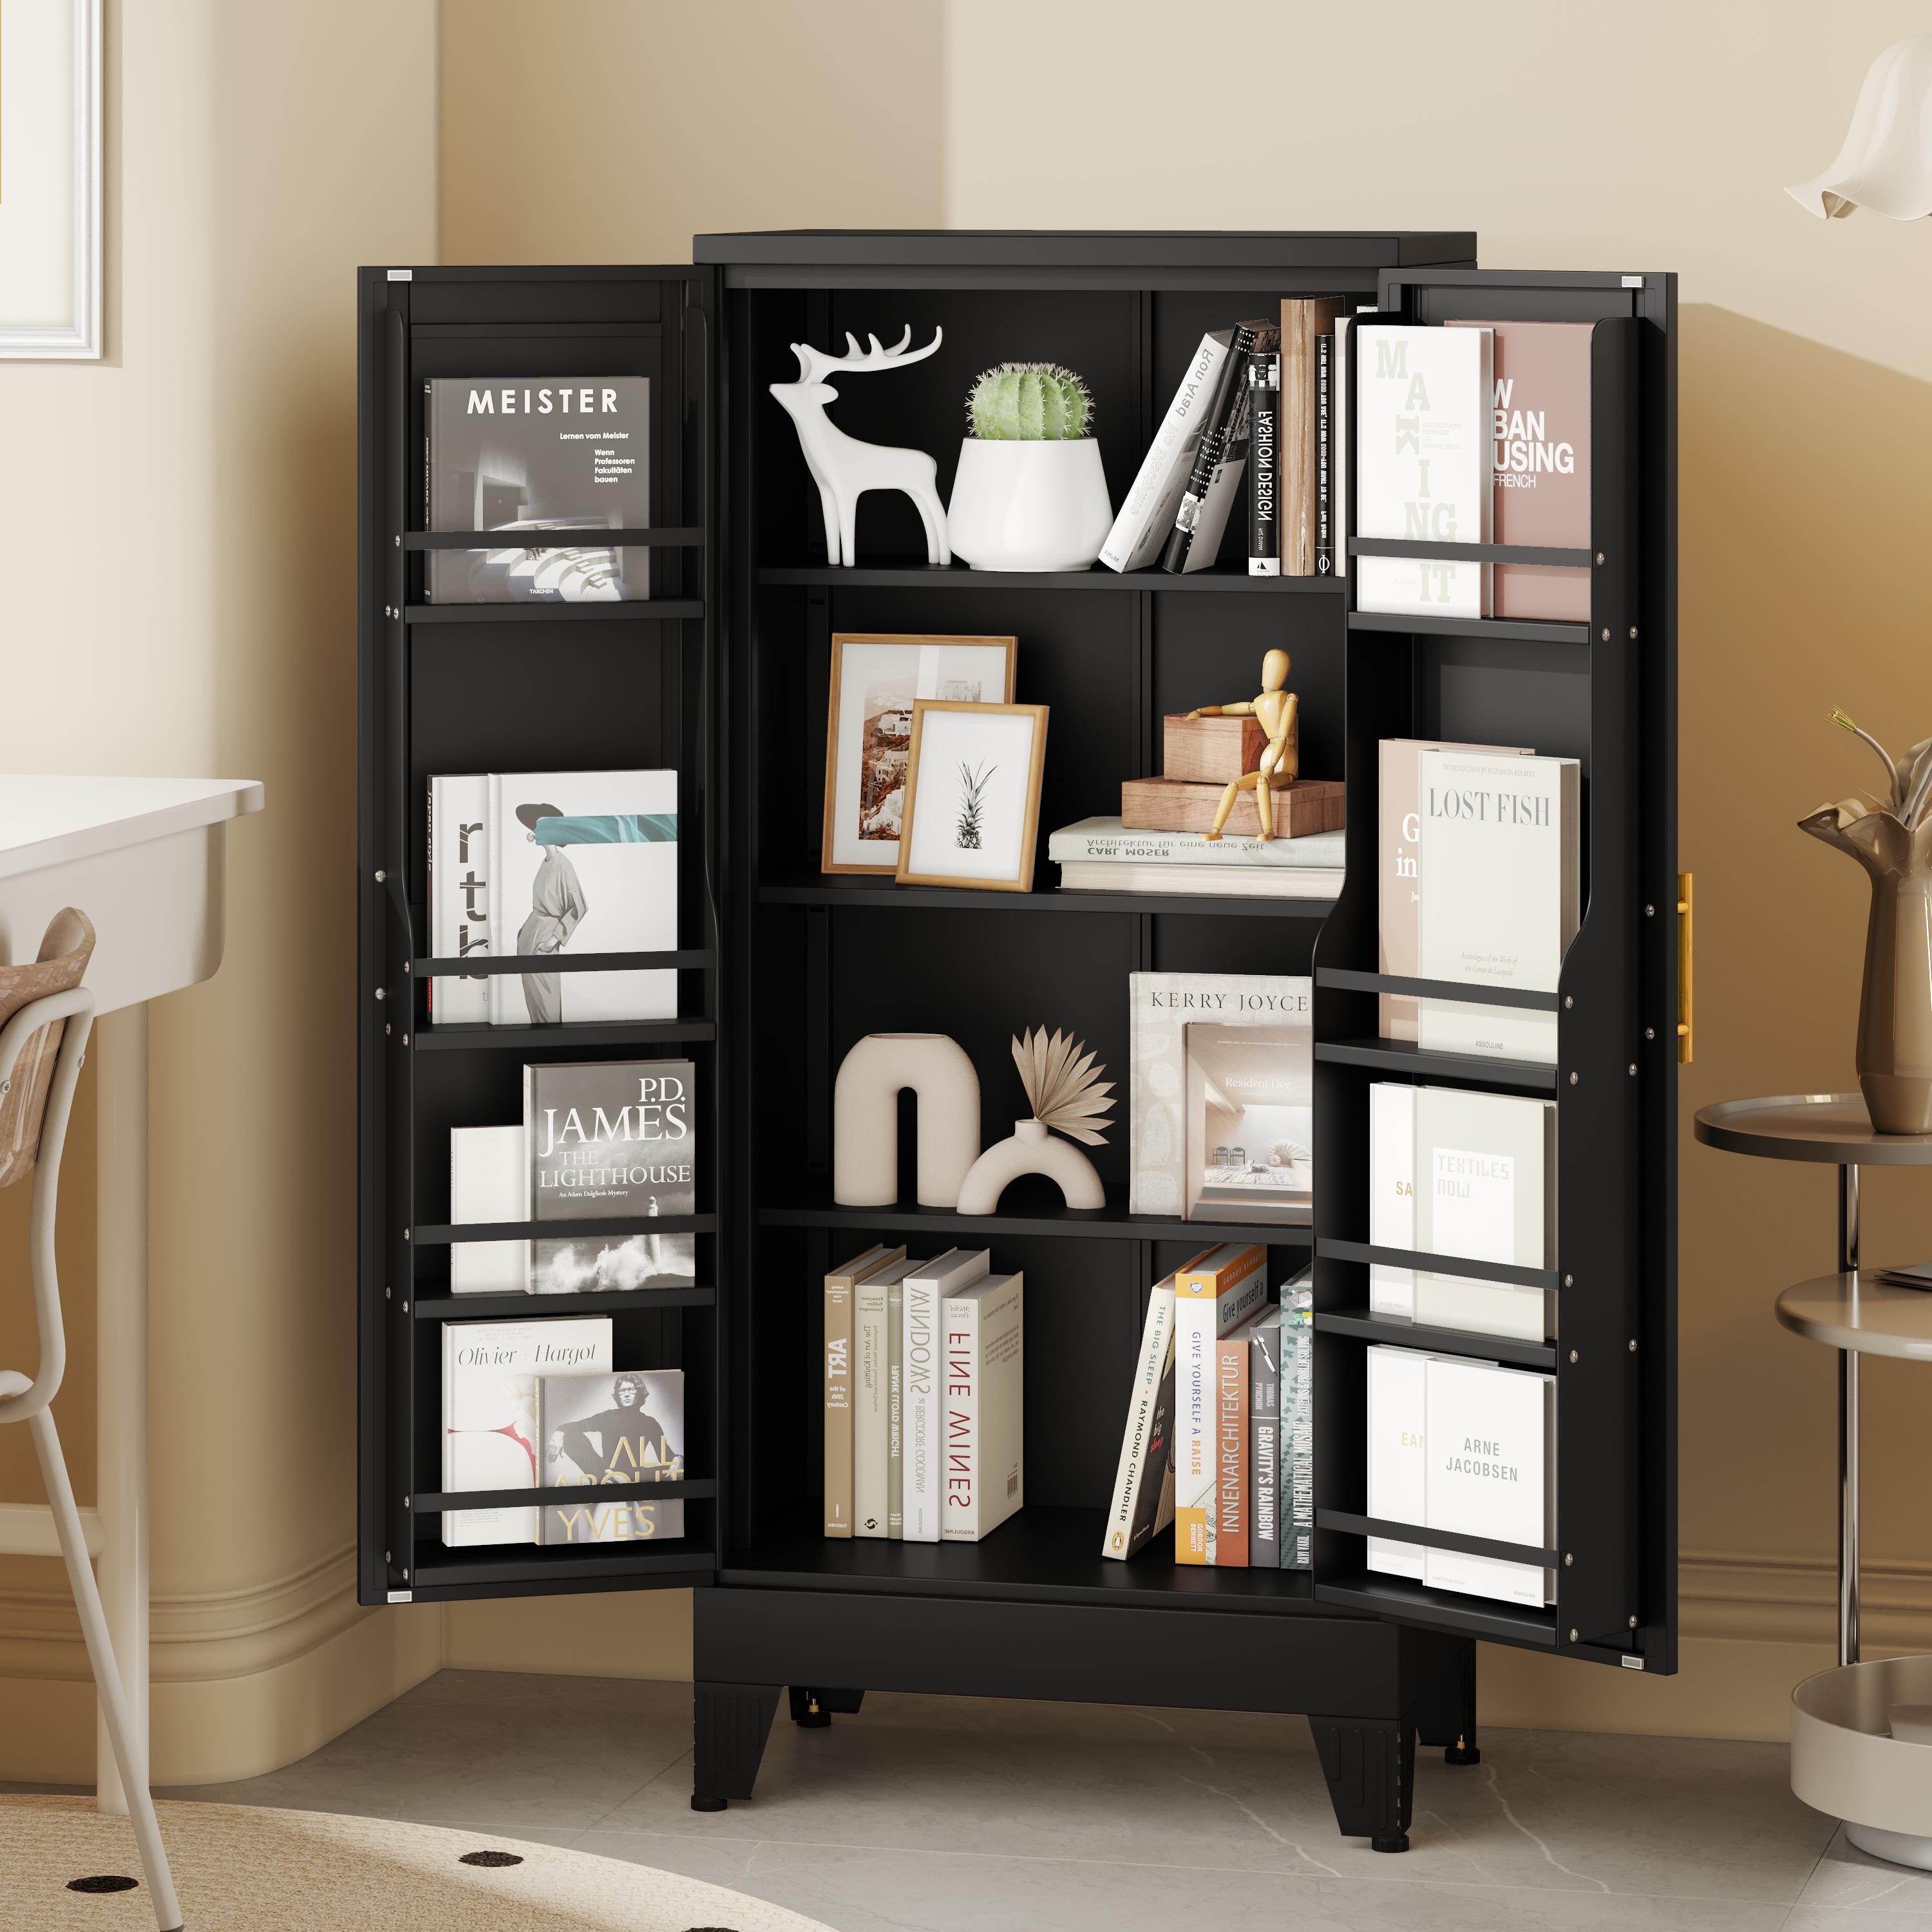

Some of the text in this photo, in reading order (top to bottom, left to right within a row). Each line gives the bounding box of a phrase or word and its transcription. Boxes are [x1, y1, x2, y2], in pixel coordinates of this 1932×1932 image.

[467, 389, 617, 413] MEISTER
[1493, 473, 1536, 488] FRENCH
[1419, 563, 1455, 603] IT
[1428, 788, 1551, 826] LOST FISH
[1151, 992, 1309, 1011] KERRY JOYCE
[1475, 1041, 1503, 1050] ASSOULINE
[638, 1077, 686, 1102] P.D.
[1226, 1077, 1291, 1090] Resident Dog
[538, 1104, 687, 1157] JAMES
[559, 1150, 598, 1165] THE
[1437, 1155, 1509, 1180] TEXTILES
[540, 1165, 690, 1188] LIGHTHOUSE
[1223, 1251, 1264, 1285] GORDON BENNETT
[1223, 1278, 1263, 1323] Give yourself a
[459, 1347, 517, 1365] Olivier
[1146, 1306, 1166, 1385] THE BIG SLEEP
[1192, 1332, 1200, 1358] GIVE
[1298, 1336, 1310, 1358] SOLVING
[1298, 1361, 1310, 1383] PROBLEM
[1192, 1362, 1201, 1423] YOURSELF
[1255, 1383, 1264, 1410] PYNCHON
[1298, 1388, 1310, 1416] PATTERNS
[1222, 1354, 1240, 1533] INNENARCHITEKTUR
[1293, 1421, 1312, 1454] MOSAIC
[1464, 1437, 1500, 1457] ARNE
[1119, 1400, 1148, 1522] RAYMOND CHANDLER
[1192, 1440, 1201, 1475] RAISE
[1446, 1457, 1517, 1482] JACOBSEN
[1258, 1426, 1274, 1540] GRAVITY'S RAINBOW
[1293, 1455, 1312, 1519] MATHEMATICAL
[557, 1506, 655, 1541] YVES
[1297, 1535, 1309, 1564] RAVI VAKIL
